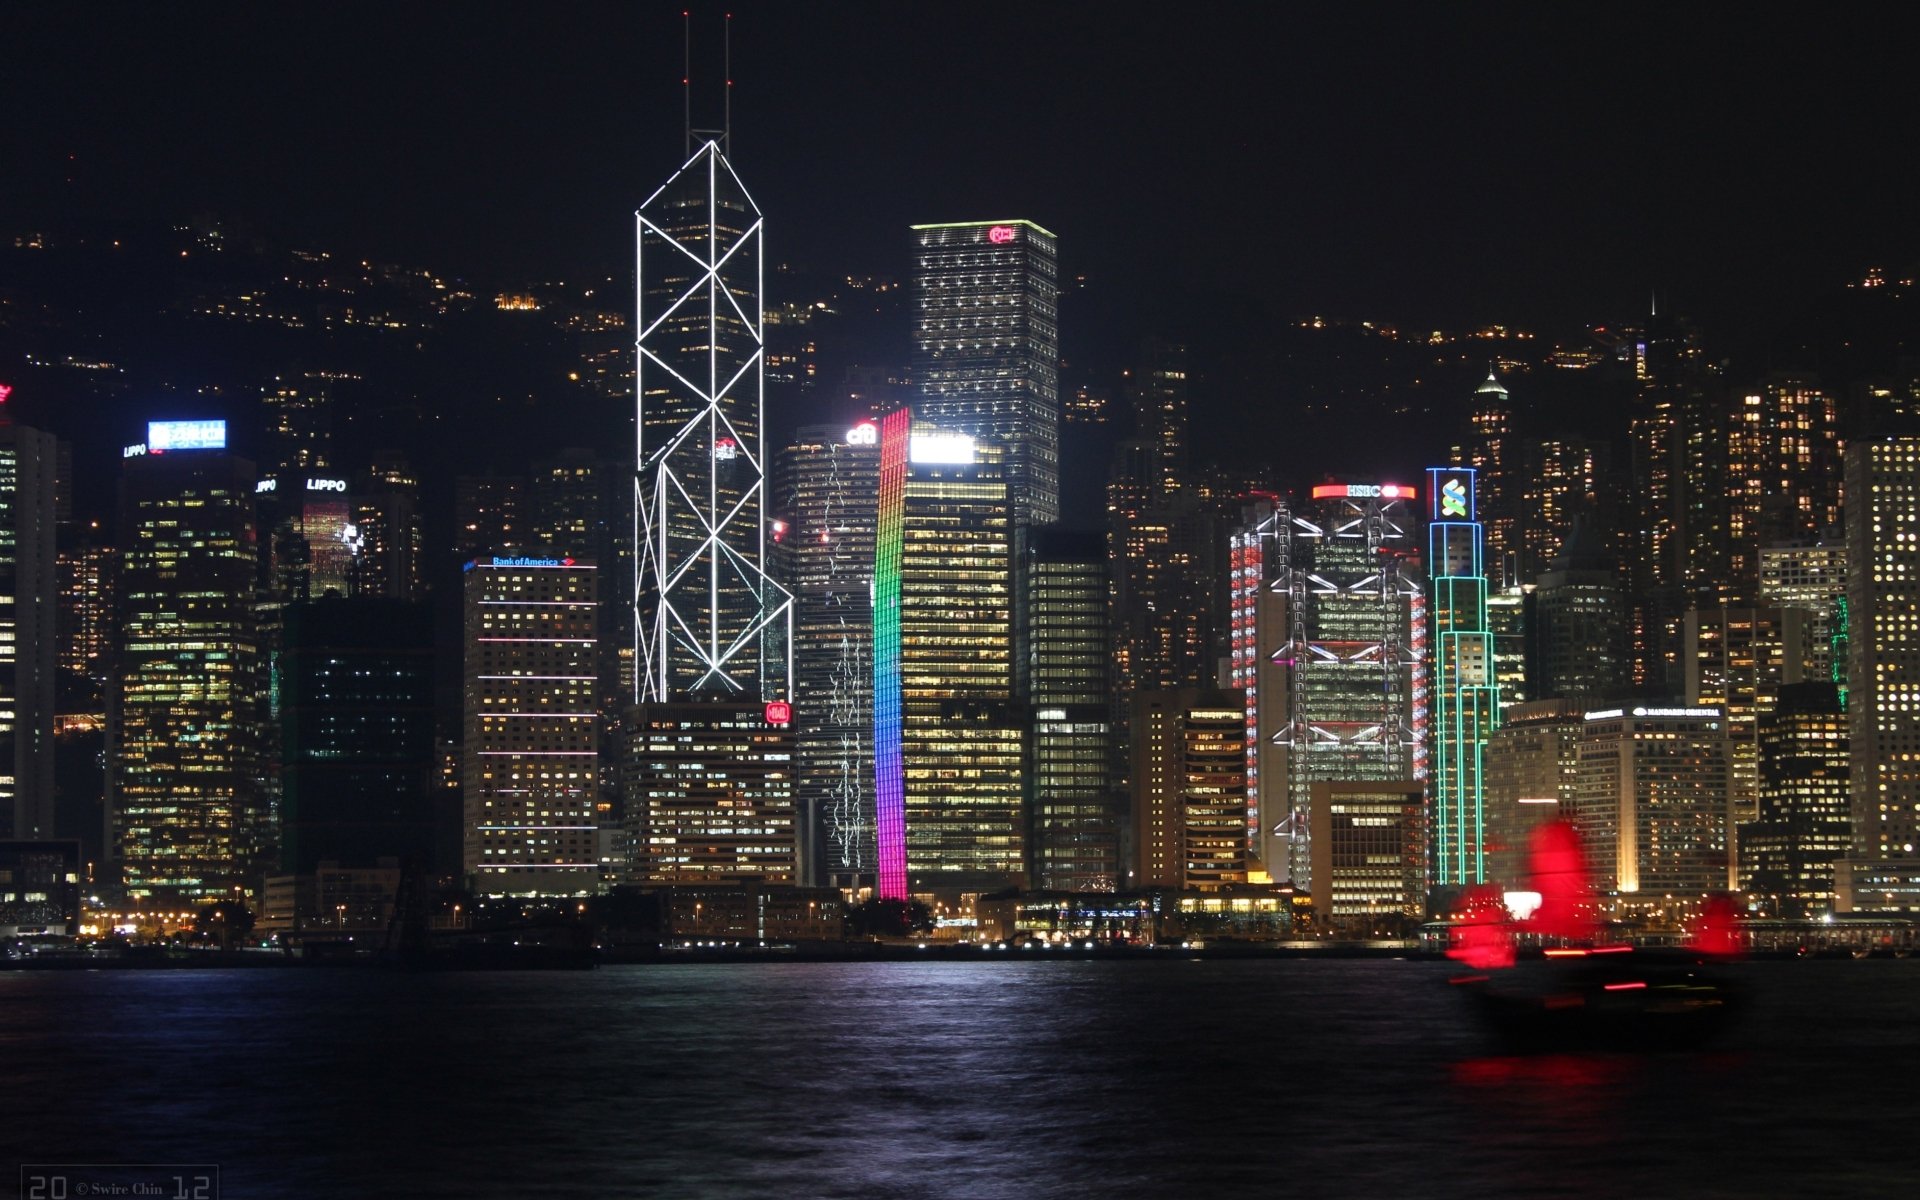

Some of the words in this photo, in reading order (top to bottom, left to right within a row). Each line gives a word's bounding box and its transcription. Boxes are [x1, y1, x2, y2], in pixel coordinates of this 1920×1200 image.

[846, 423, 877, 444] citi
[123, 444, 147, 458] LIPPO
[306, 478, 347, 492] LIPPO
[1346, 484, 1381, 498] HSBC
[493, 557, 514, 566] Bank
[514, 557, 525, 566] of
[524, 557, 558, 567] America
